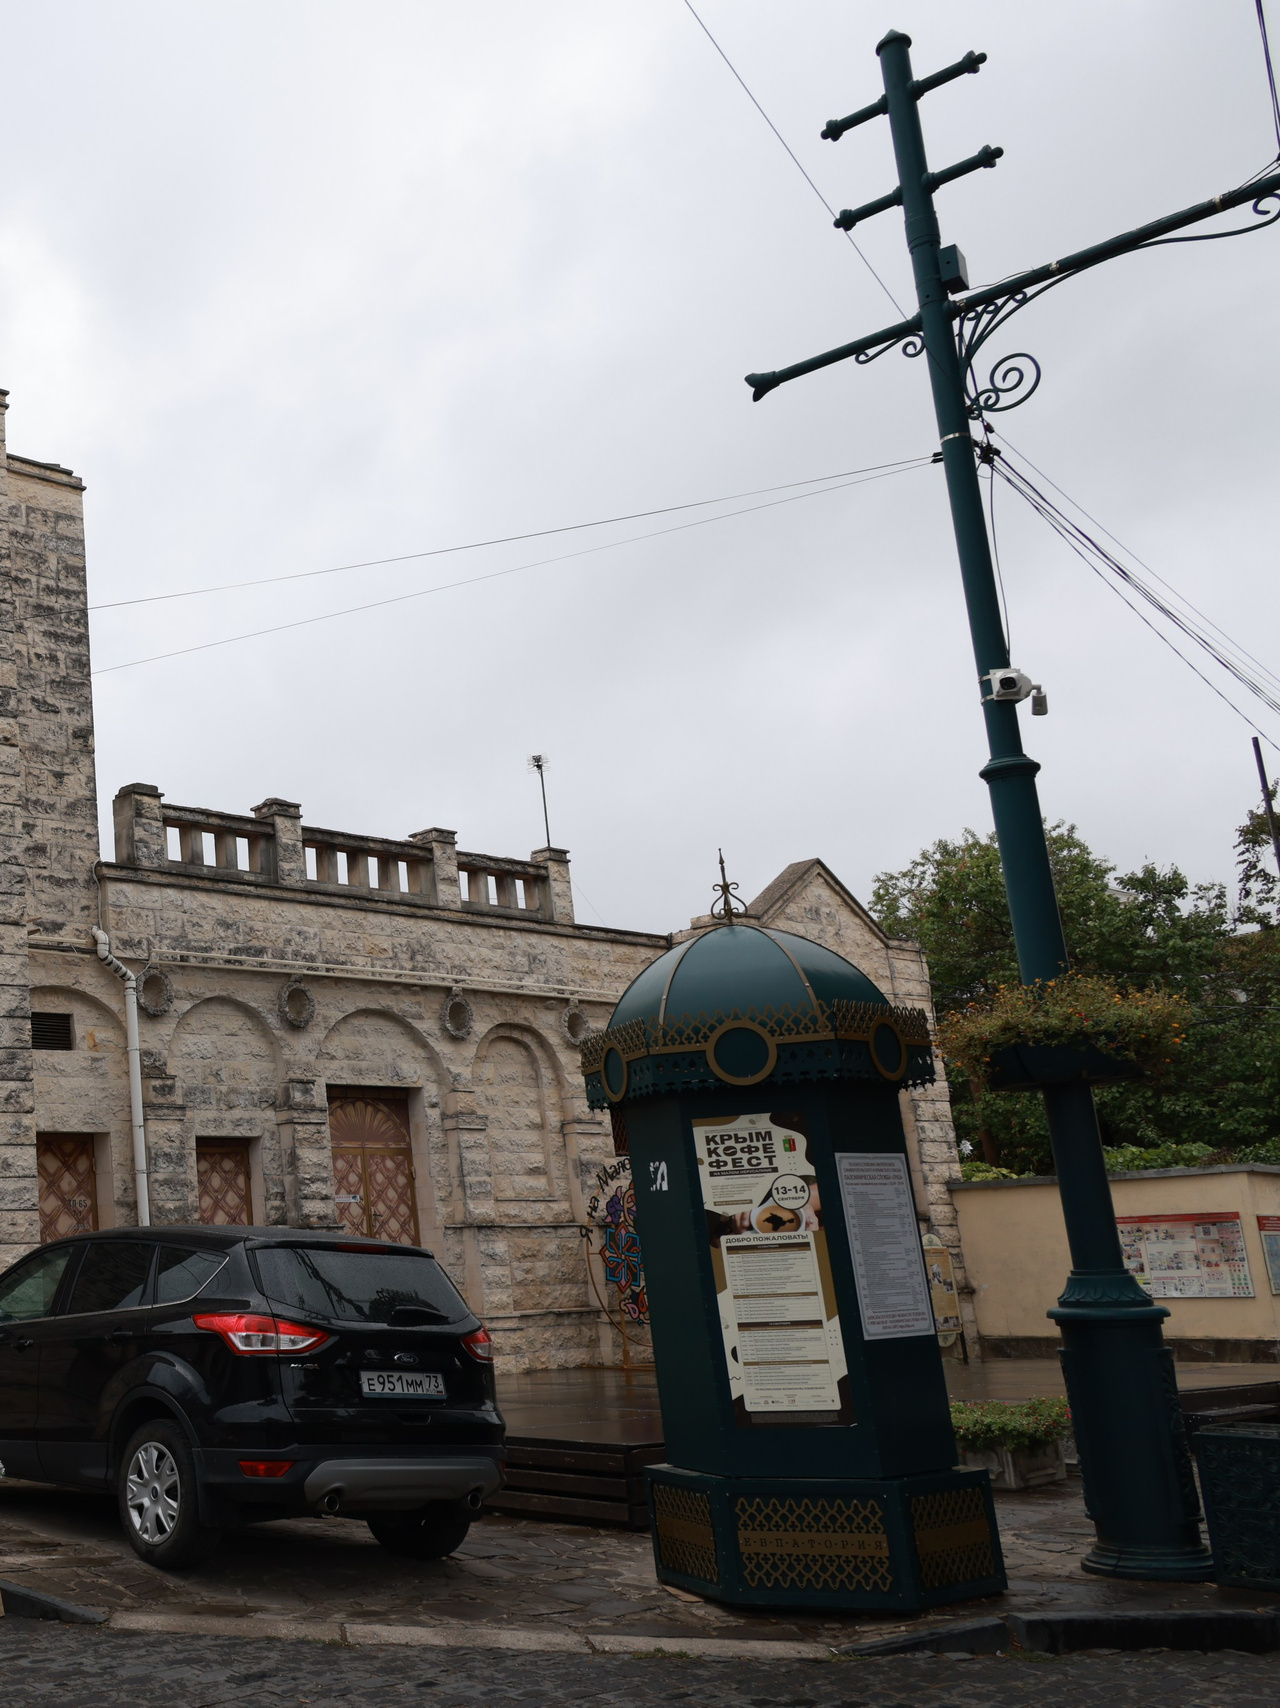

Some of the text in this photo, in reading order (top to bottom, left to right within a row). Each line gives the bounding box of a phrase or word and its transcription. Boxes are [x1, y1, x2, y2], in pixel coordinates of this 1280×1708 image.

[705, 1130, 773, 1146] КРЫМ
[706, 1143, 776, 1158] КОФЕ
[708, 1155, 777, 1170] ФЕСТ
[774, 1185, 806, 1195] 13-14
[586, 1195, 600, 1220] на
[753, 1234, 809, 1242] ПОЖАЛОВАТЬ!
[400, 1354, 414, 1363] Ford
[425, 1375, 440, 1388] 73
